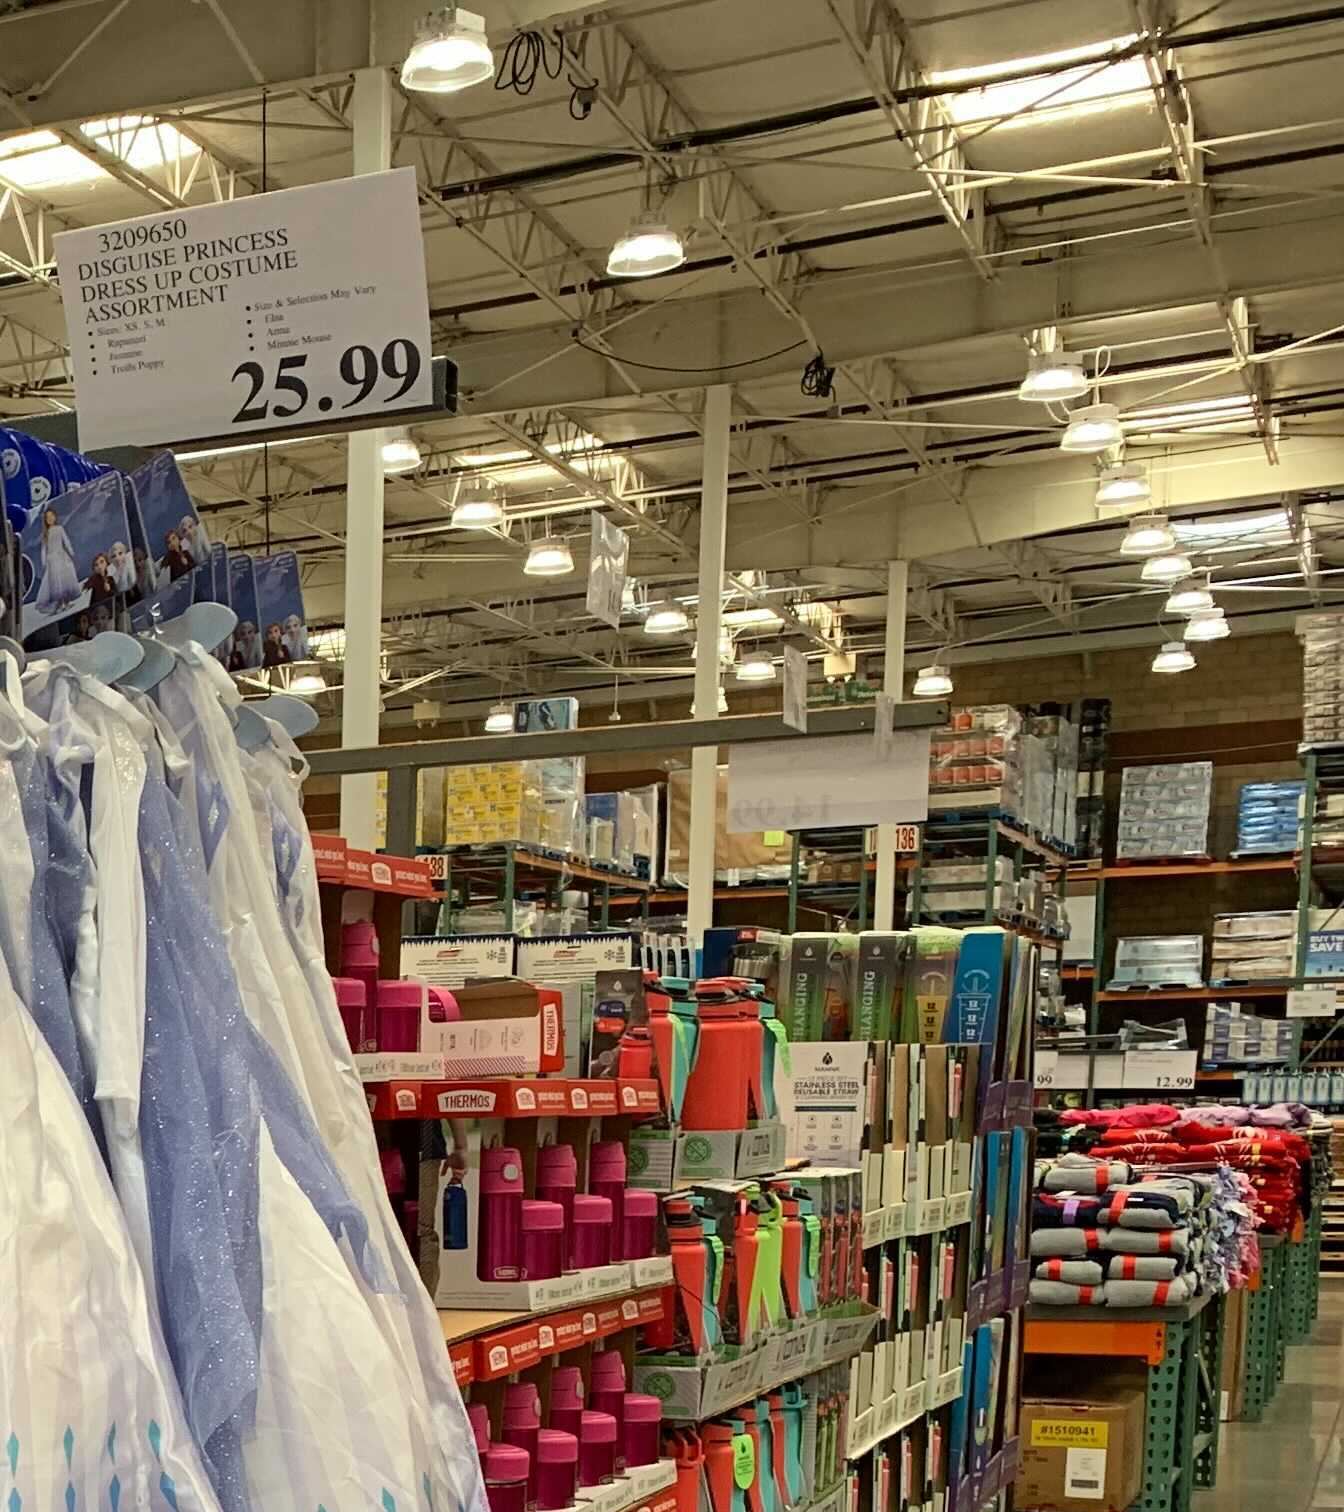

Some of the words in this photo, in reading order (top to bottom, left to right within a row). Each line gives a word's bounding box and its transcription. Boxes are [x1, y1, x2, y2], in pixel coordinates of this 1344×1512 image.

[99, 218, 187, 253] 3209650
[78, 247, 177, 281] DISGUISE
[184, 228, 289, 263] PRINCESS
[81, 275, 148, 303] DRESS
[154, 270, 182, 291] UP
[189, 250, 299, 284] COSTUME
[86, 284, 229, 325] ASSORTMENT
[231, 337, 422, 424] 25.99
[896, 828, 916, 850] 136
[1310, 943, 1343, 952] SAVE
[792, 972, 808, 1038] HANGING
[545, 1009, 556, 1053] THERMOS
[794, 1081, 836, 1090] STAINLESS
[838, 1081, 859, 1089] STEEL
[794, 1088, 831, 1096] REUSABLE
[1156, 1076, 1193, 1088] 12.99
[444, 1093, 490, 1110] THERMOS
[1039, 1425, 1097, 1436] #1510941
